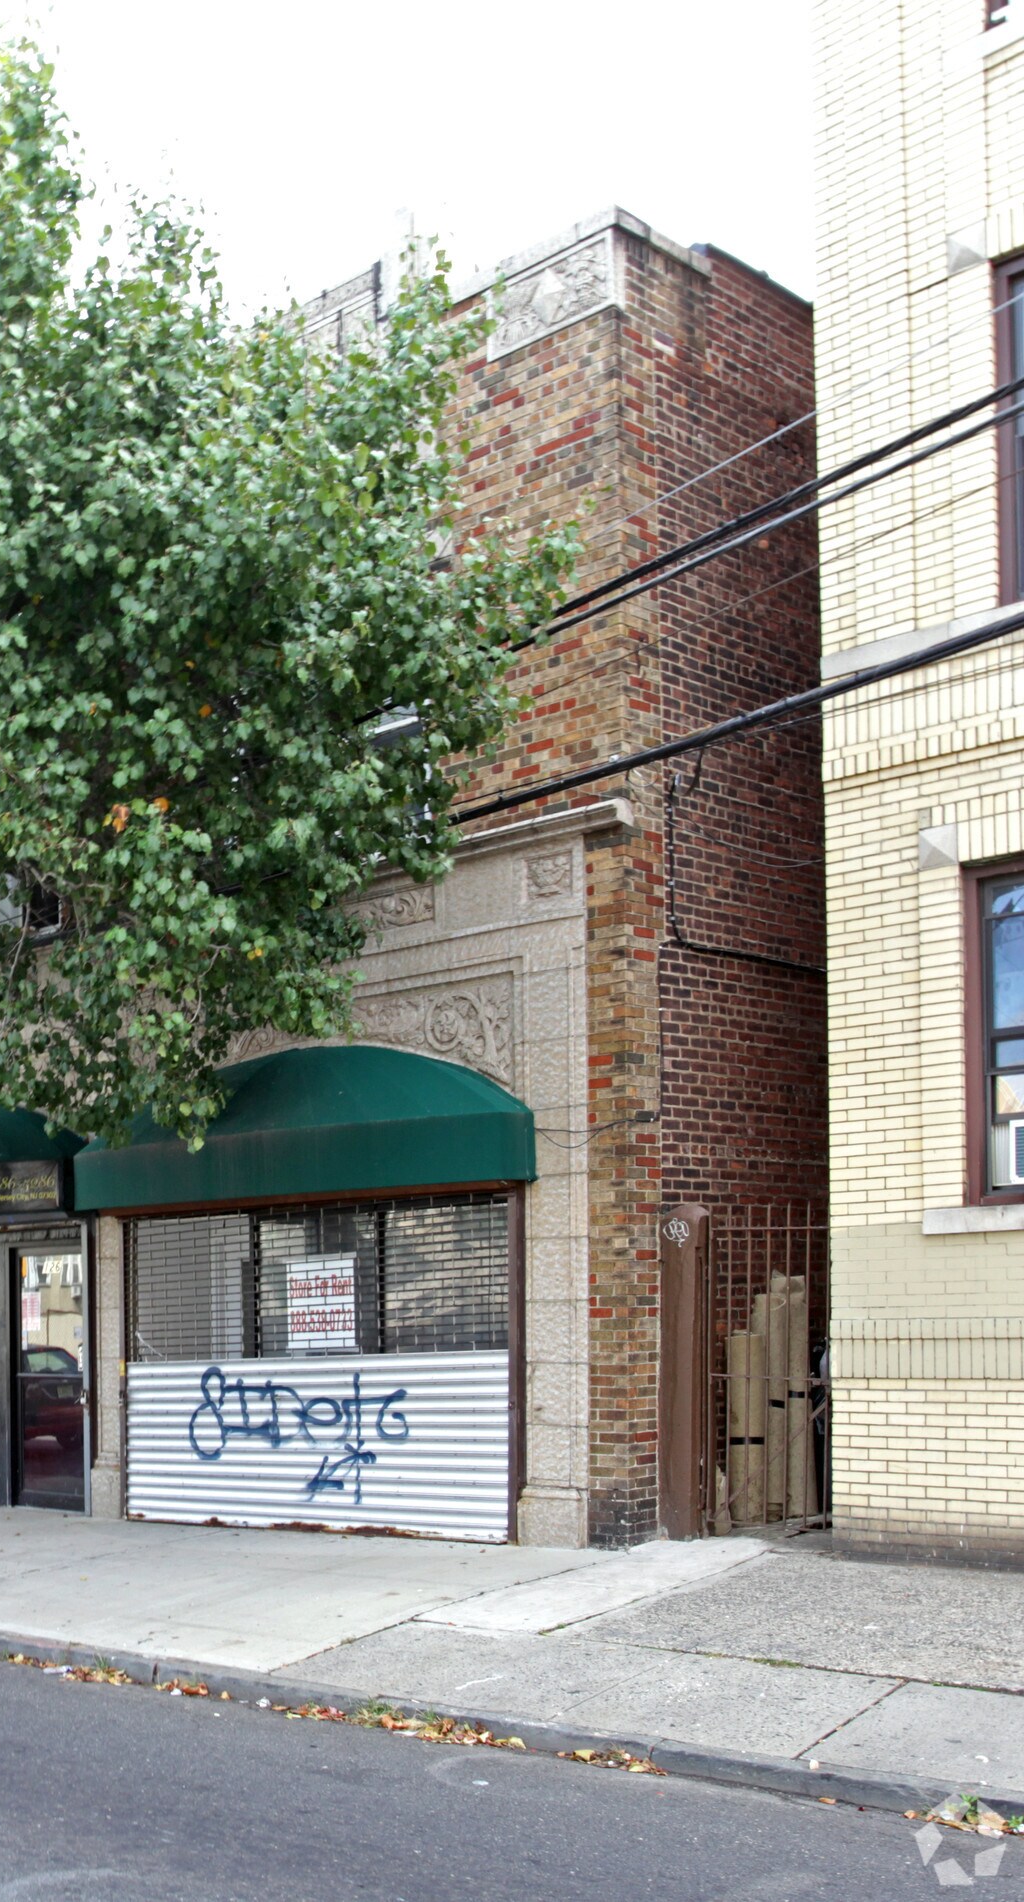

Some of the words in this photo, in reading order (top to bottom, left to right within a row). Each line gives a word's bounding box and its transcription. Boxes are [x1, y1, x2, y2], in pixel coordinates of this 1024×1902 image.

[289, 1276, 313, 1298] Store
[314, 1274, 330, 1297] For
[331, 1273, 353, 1296] Rent
